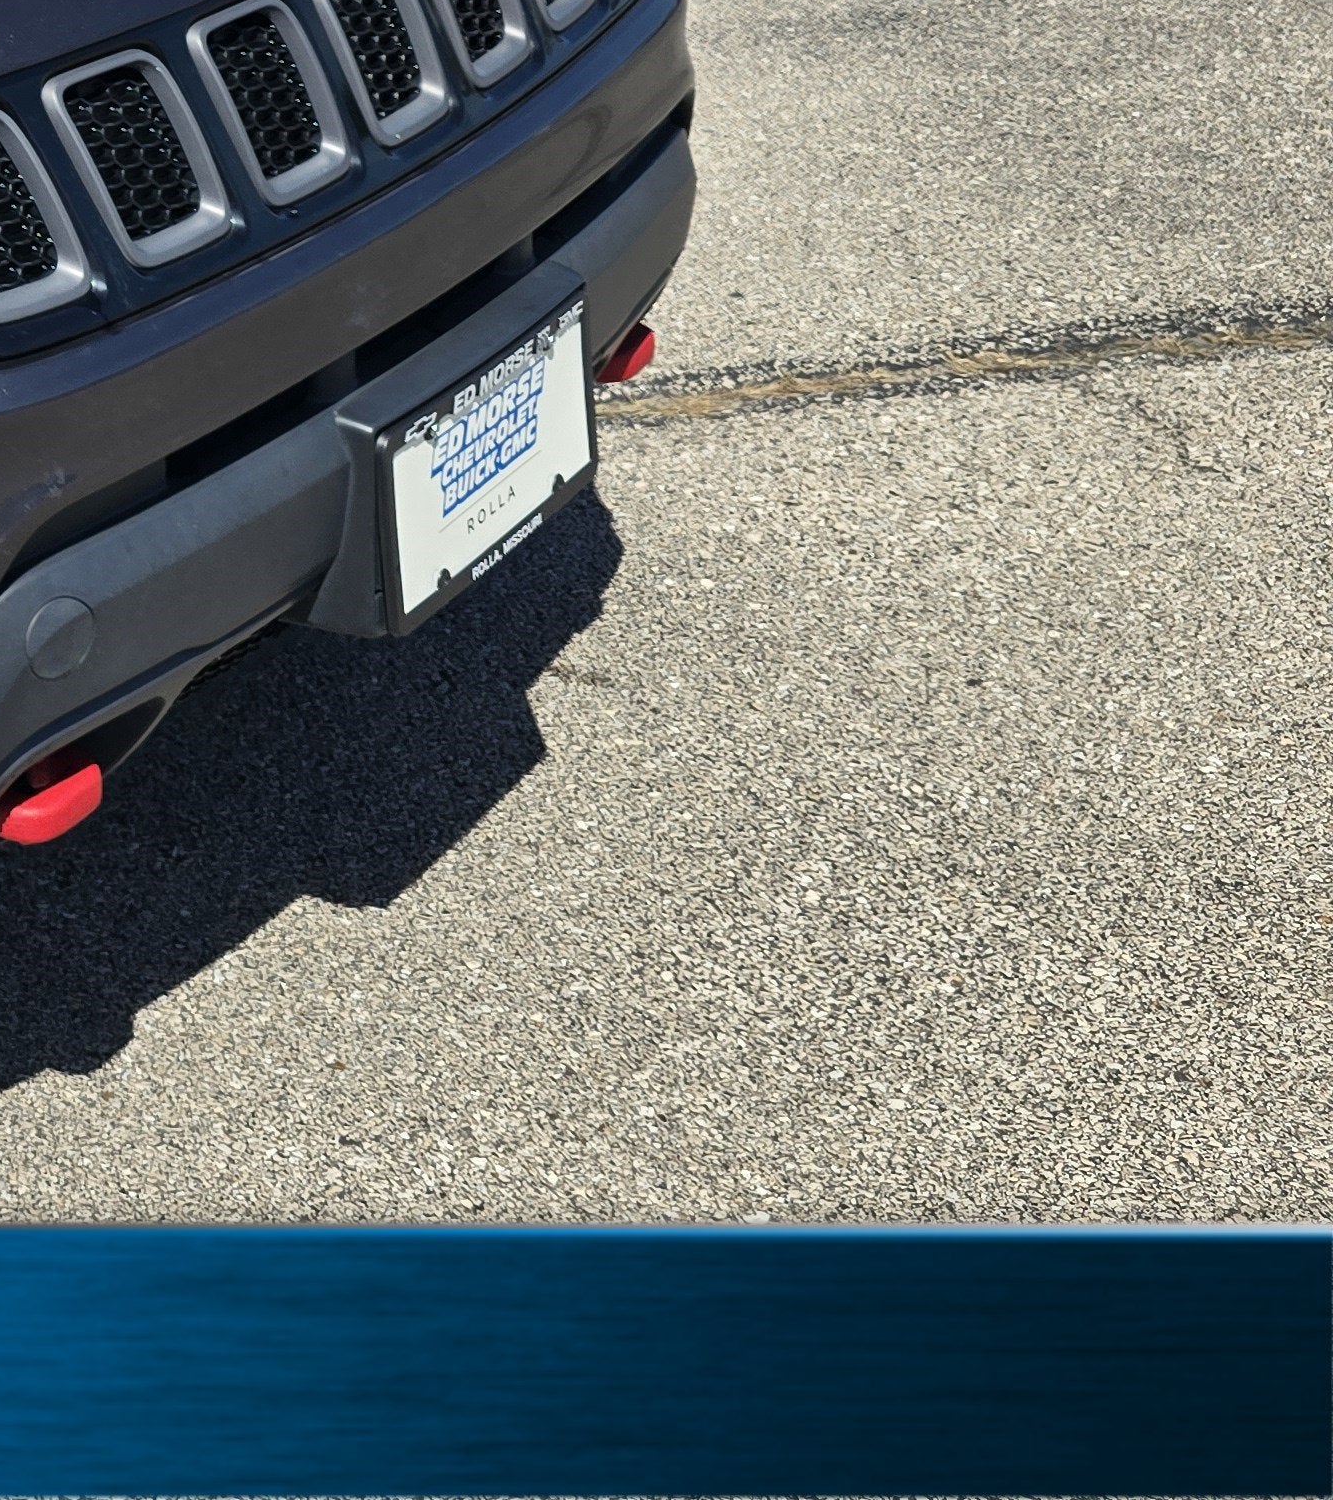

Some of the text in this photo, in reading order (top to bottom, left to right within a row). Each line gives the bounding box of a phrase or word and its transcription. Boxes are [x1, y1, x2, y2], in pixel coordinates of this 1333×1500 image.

[432, 358, 545, 476] ED MORSE
[441, 393, 538, 489] CHEVROLET
[466, 485, 516, 535] ROLLA
